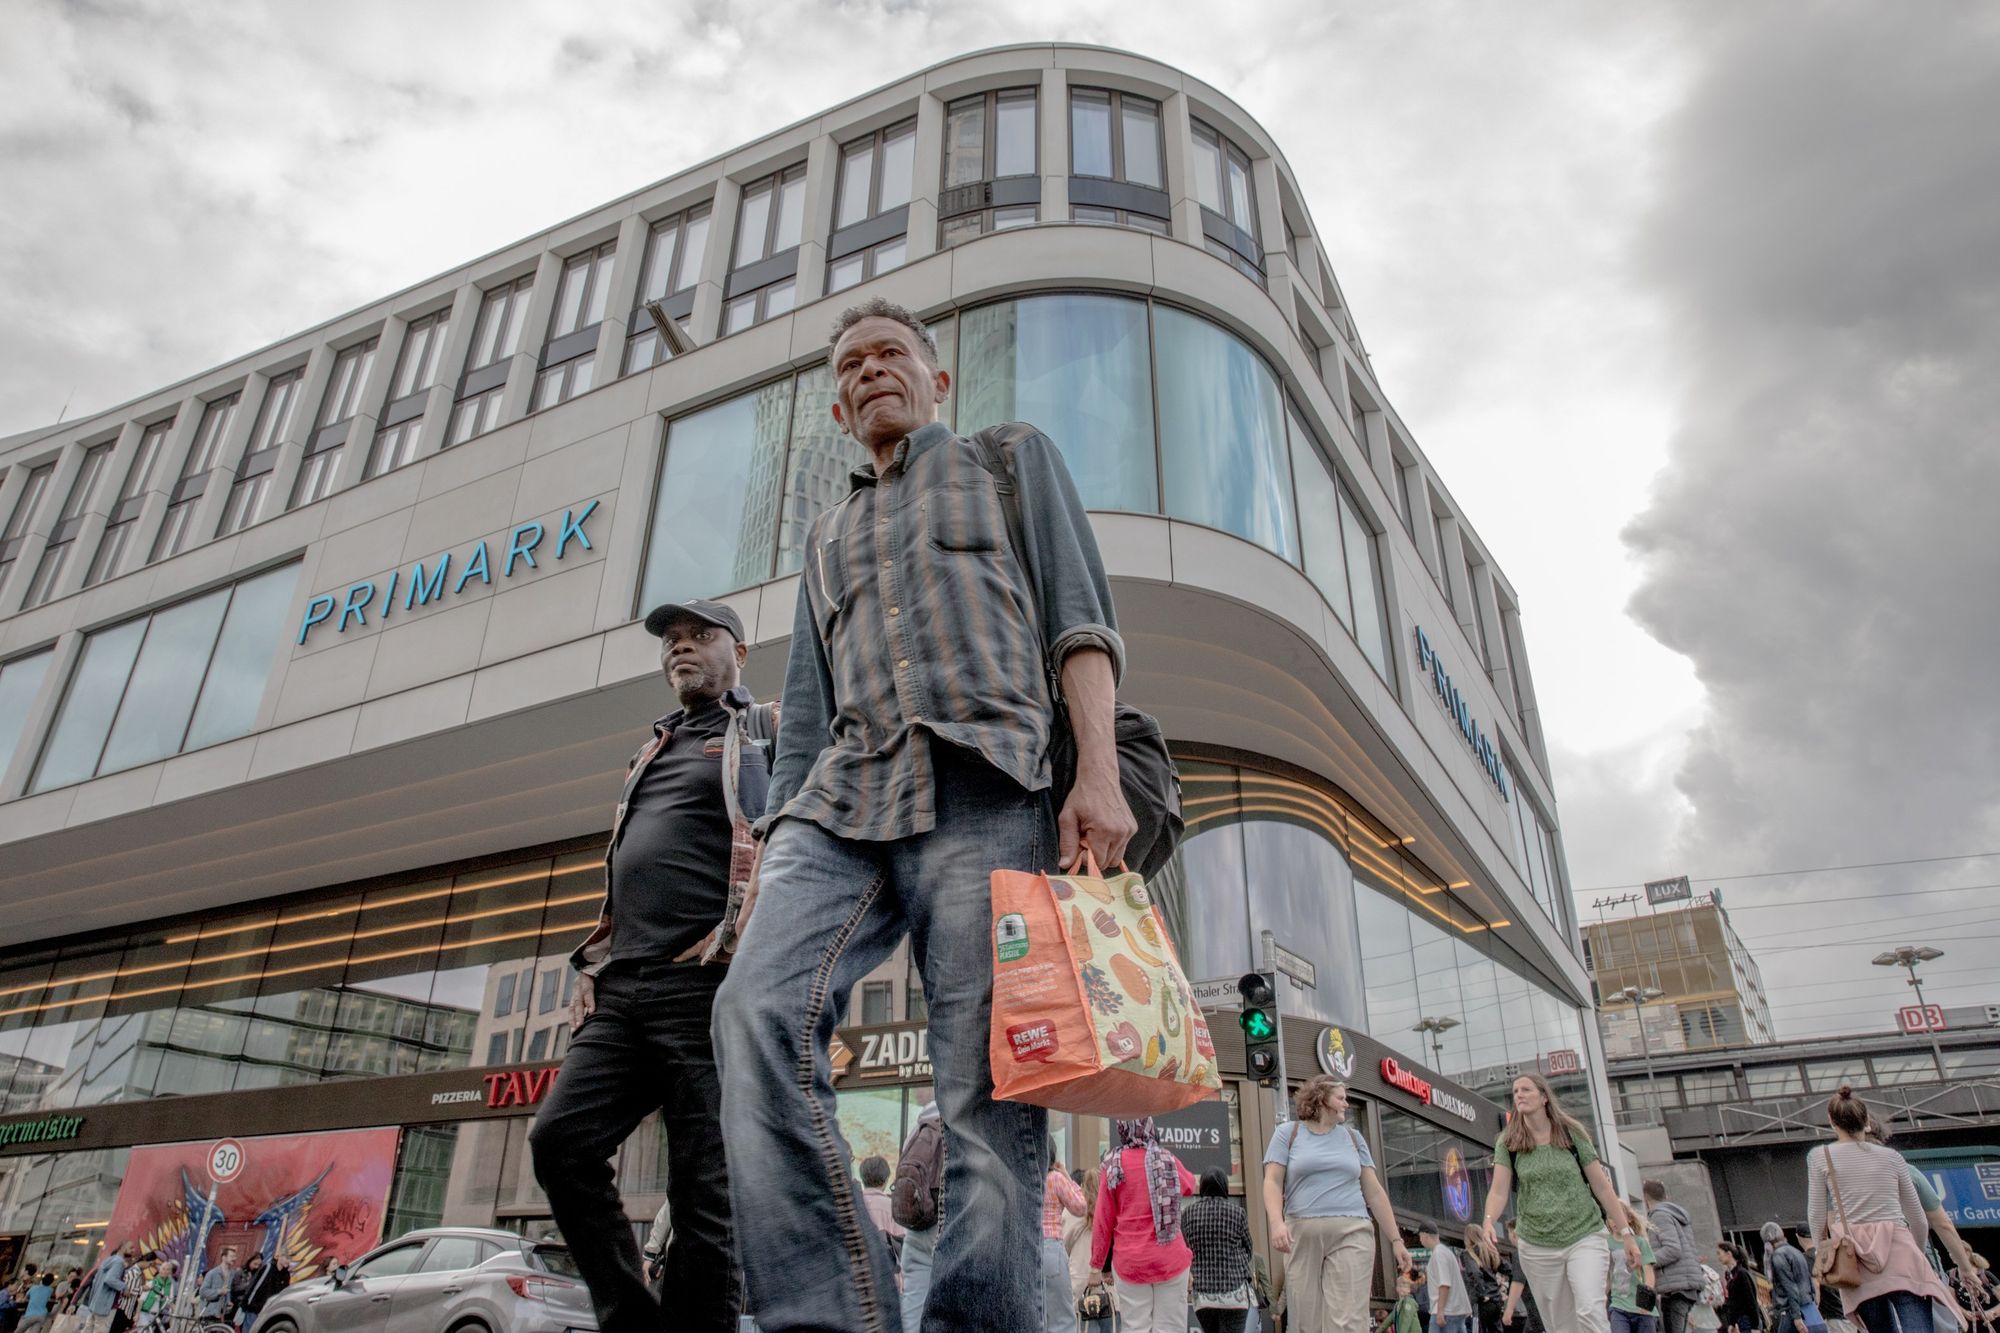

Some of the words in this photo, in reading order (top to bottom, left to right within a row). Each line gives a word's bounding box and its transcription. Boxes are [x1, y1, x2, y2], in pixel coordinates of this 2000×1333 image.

[296, 499, 600, 646] PRIMARK
[1415, 624, 1509, 803] PRIMARK
[1654, 882, 1681, 896] LUX
[1905, 1008, 1940, 1027] DB
[1013, 1025, 1048, 1046] REWE
[1380, 1057, 1432, 1106] Chutney
[431, 1090, 482, 1104] PIZZERIA
[215, 1150, 238, 1170] 30
